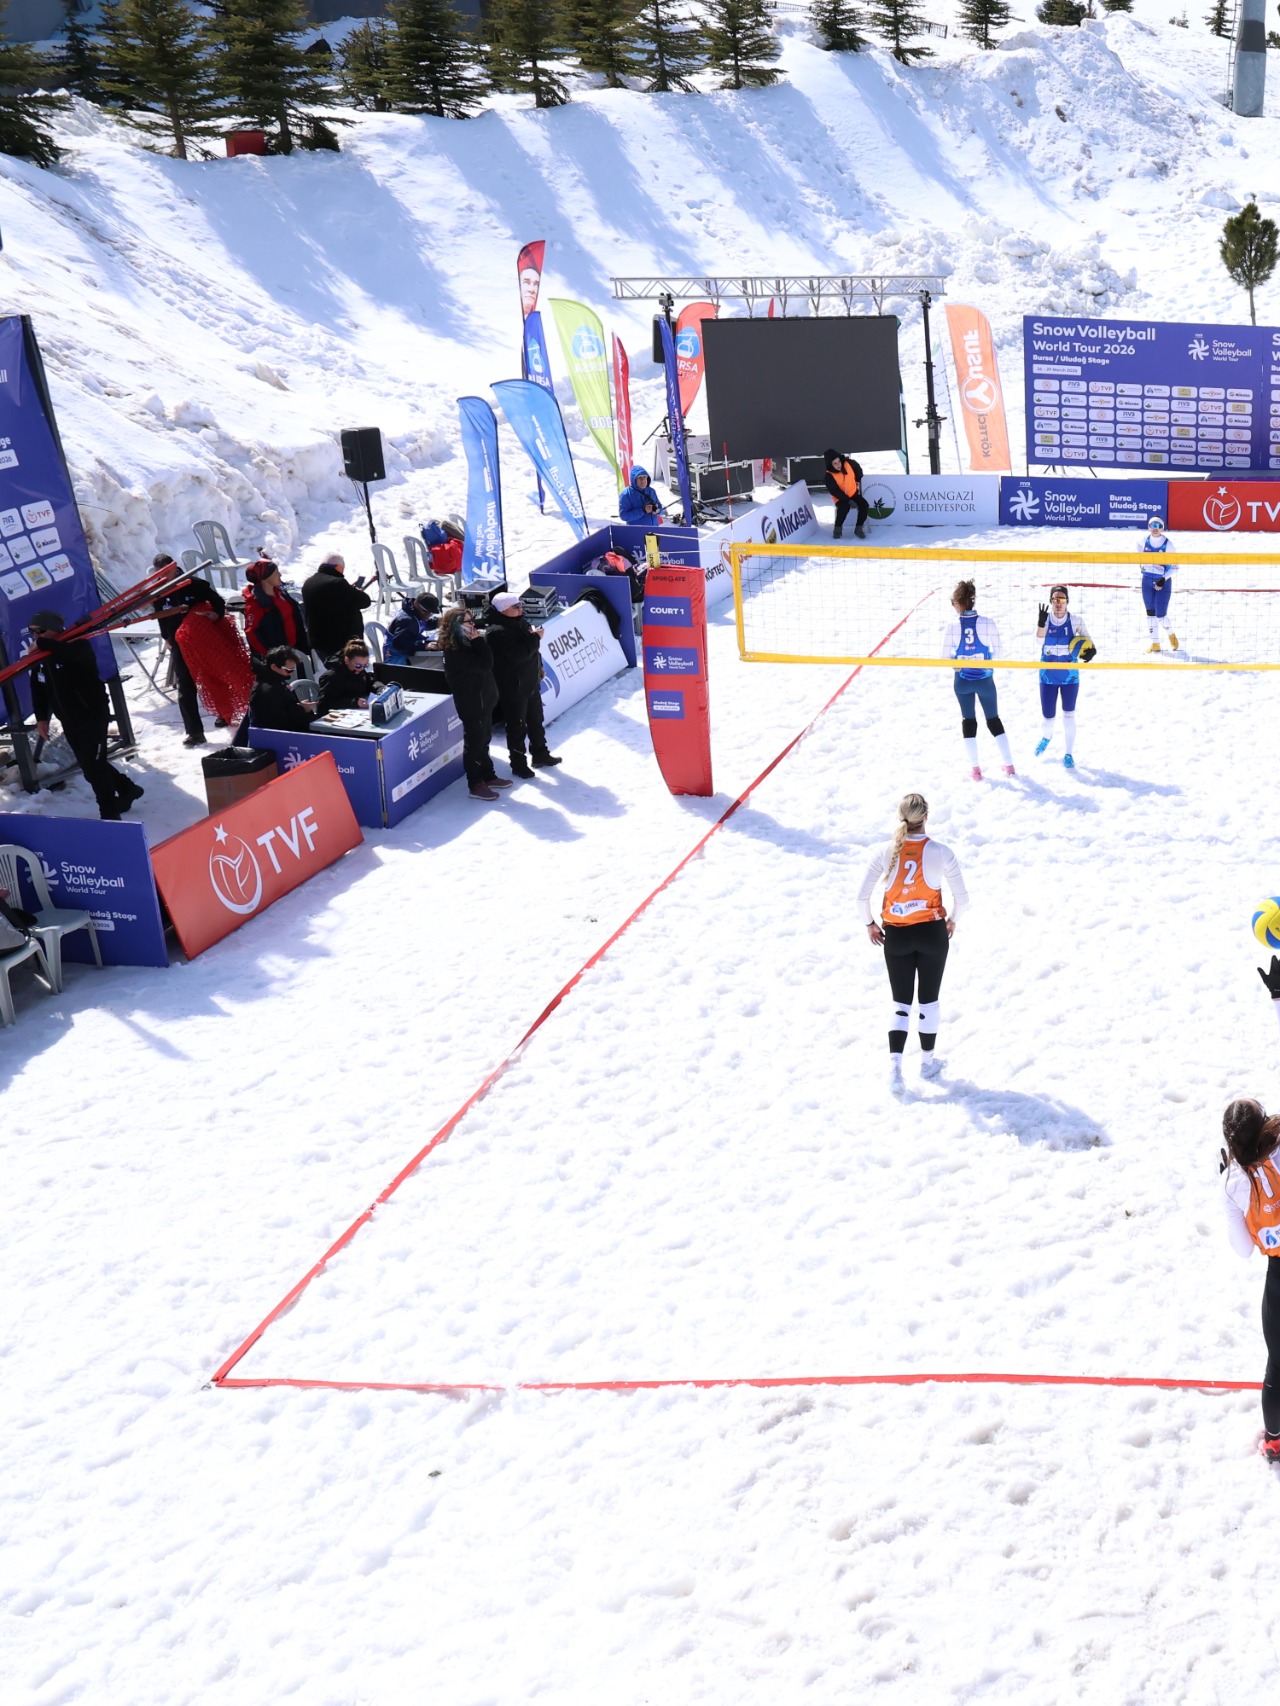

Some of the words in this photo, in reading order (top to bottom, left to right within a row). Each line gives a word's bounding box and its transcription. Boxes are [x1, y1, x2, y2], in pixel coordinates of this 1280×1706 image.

[1032, 322, 1076, 337] Snow
[1077, 324, 1155, 342] Volleyball
[1032, 340, 1069, 352] World
[1072, 342, 1101, 353] Tour
[1103, 343, 1135, 355] 2026
[1212, 339, 1235, 348] Snow
[1212, 347, 1251, 358] Volleyball
[1032, 354, 1053, 362] Bursa
[1054, 354, 1058, 363] /
[1060, 354, 1086, 365] Uludağ
[1087, 356, 1109, 365] Stage
[1044, 490, 1077, 501] Snow
[1109, 494, 1131, 502] Bursa
[904, 502, 976, 512] BELEDİYESPOR
[1044, 503, 1100, 515] Volleyball
[1109, 502, 1137, 511] Uludağ
[1138, 502, 1161, 511] Stage
[36, 509, 50, 519] TVF
[649, 606, 678, 614] COURT
[964, 627, 975, 645] 3
[1063, 626, 1068, 636] 1
[547, 626, 585, 660] BURSA
[256, 805, 320, 874] TVF
[60, 861, 96, 874] Snow
[903, 860, 917, 884] 2
[62, 873, 125, 888] Volleyball
[65, 886, 89, 894] World
[89, 887, 106, 895] Tour
[112, 911, 137, 921] Stage
